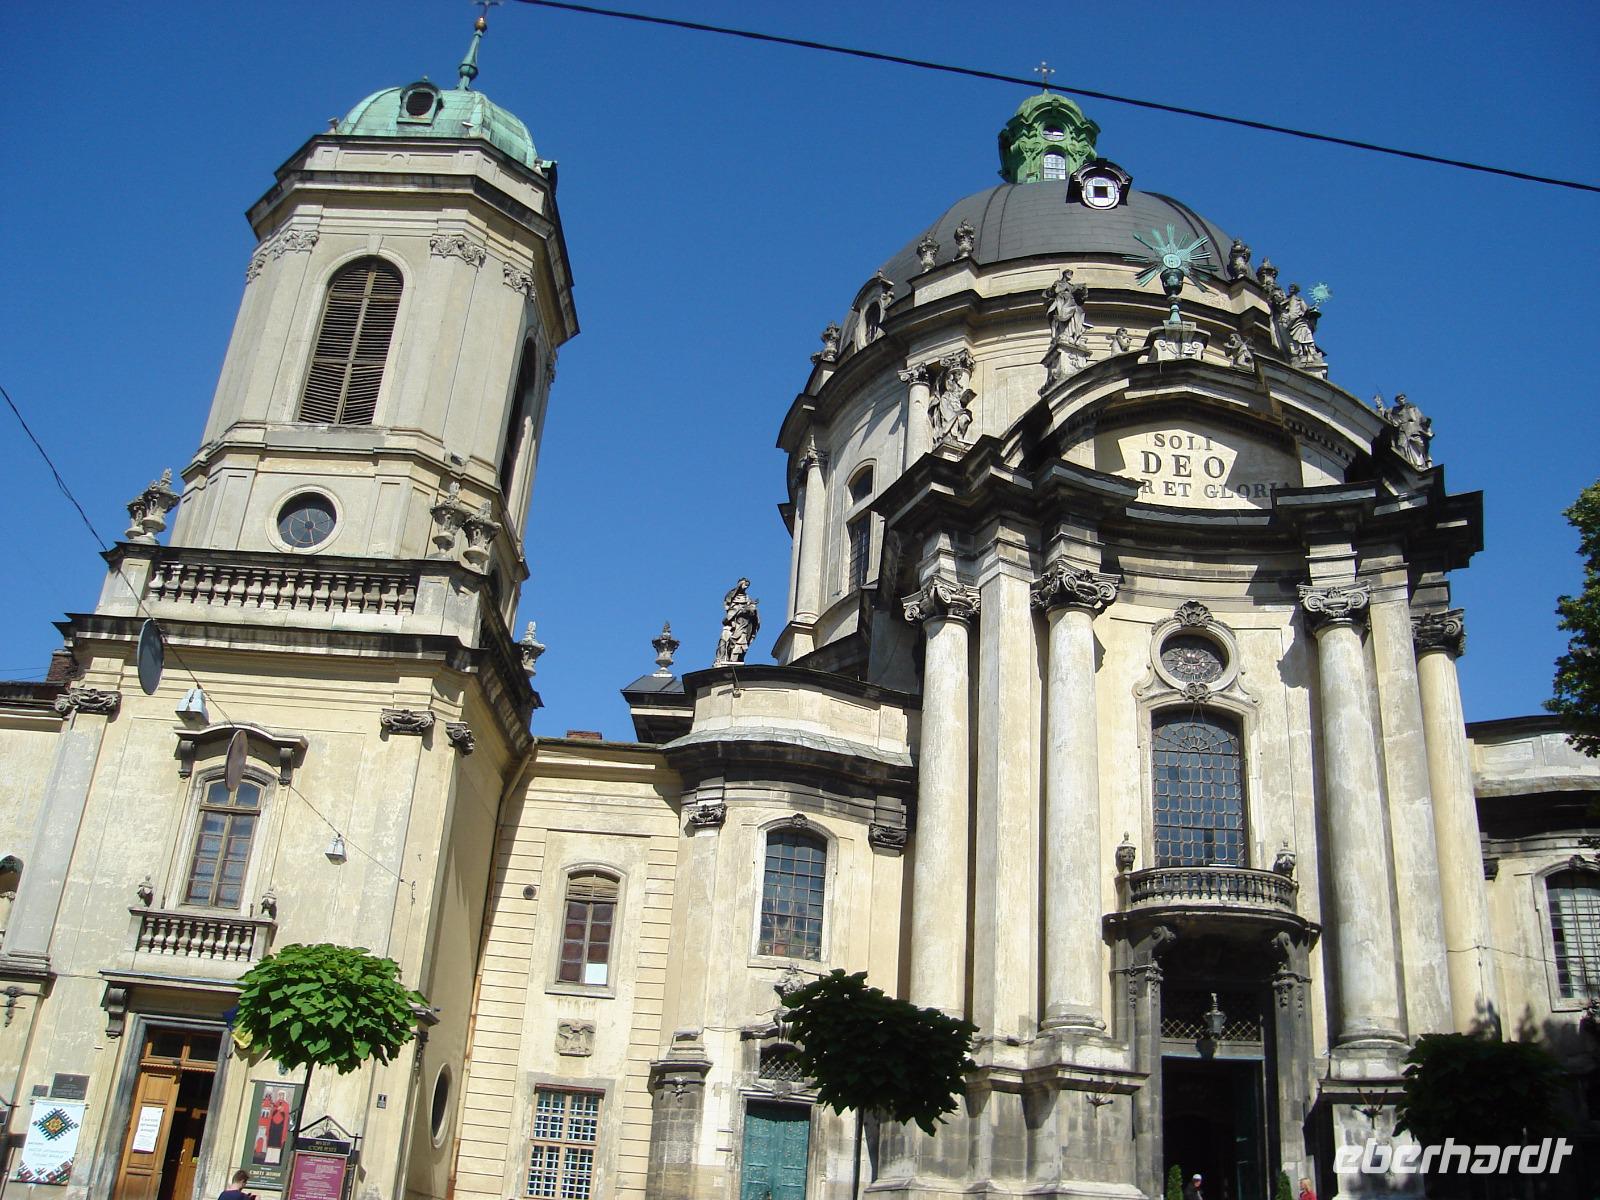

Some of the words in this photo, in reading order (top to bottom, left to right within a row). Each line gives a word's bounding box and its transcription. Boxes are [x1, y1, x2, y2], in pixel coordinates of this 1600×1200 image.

[1154, 433, 1213, 451] SOLI
[1141, 450, 1226, 479] DEO
[1162, 480, 1192, 497] ET
